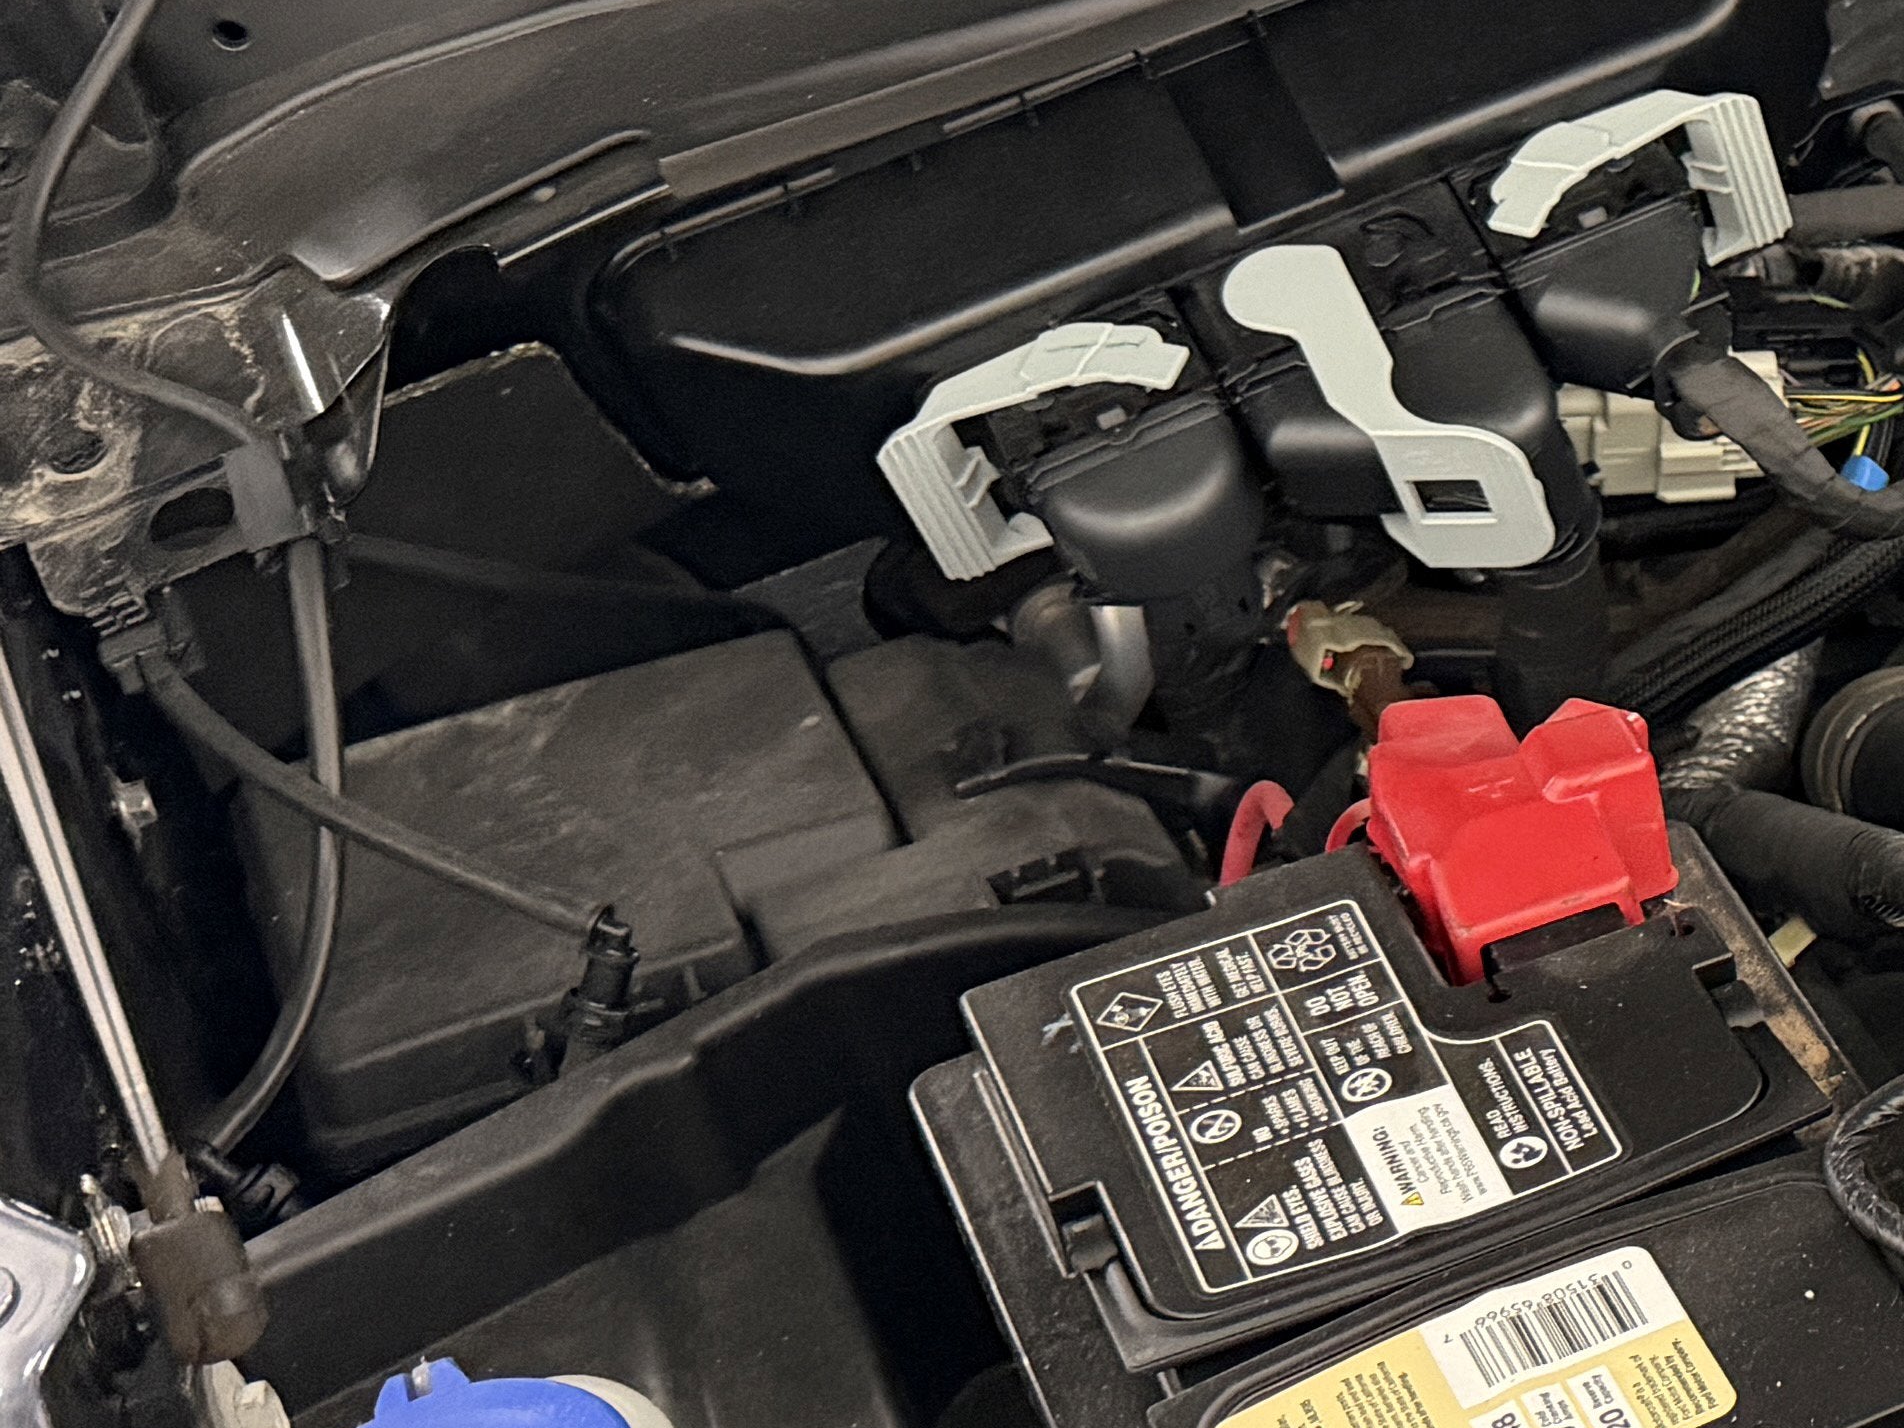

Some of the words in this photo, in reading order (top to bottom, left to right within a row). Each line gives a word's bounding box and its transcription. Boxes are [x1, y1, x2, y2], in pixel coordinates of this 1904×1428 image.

[1304, 995, 1330, 1016] DO
[1325, 985, 1354, 1011] NOT
[1201, 1020, 1225, 1043] ACID
[1232, 1034, 1257, 1062] CAUSE
[1211, 1042, 1246, 1086] SULFURIC
[1246, 1060, 1265, 1079] CAN
[1538, 1048, 1568, 1086] Battery
[1478, 1057, 1528, 1133] INSTRUCTIONS.
[1513, 1047, 1584, 1151] NON-SPILLABLE
[1557, 1085, 1582, 1109] Acid
[1252, 1125, 1272, 1142] NO
[1485, 1109, 1511, 1138] READ
[1570, 1109, 1597, 1137] Lead
[1124, 1075, 1216, 1236] DANGER/POISON
[1372, 1126, 1416, 1195] WARNING:
[1293, 1156, 1322, 1189] GASES
[1281, 1184, 1307, 1215] EYES.
[1330, 1184, 1356, 1214] CAUSE
[1308, 1187, 1347, 1241] EXPLOSIVE
[1344, 1213, 1365, 1233] CAN
[1365, 1209, 1383, 1226] OR
[1294, 1213, 1323, 1249] SHIELD
